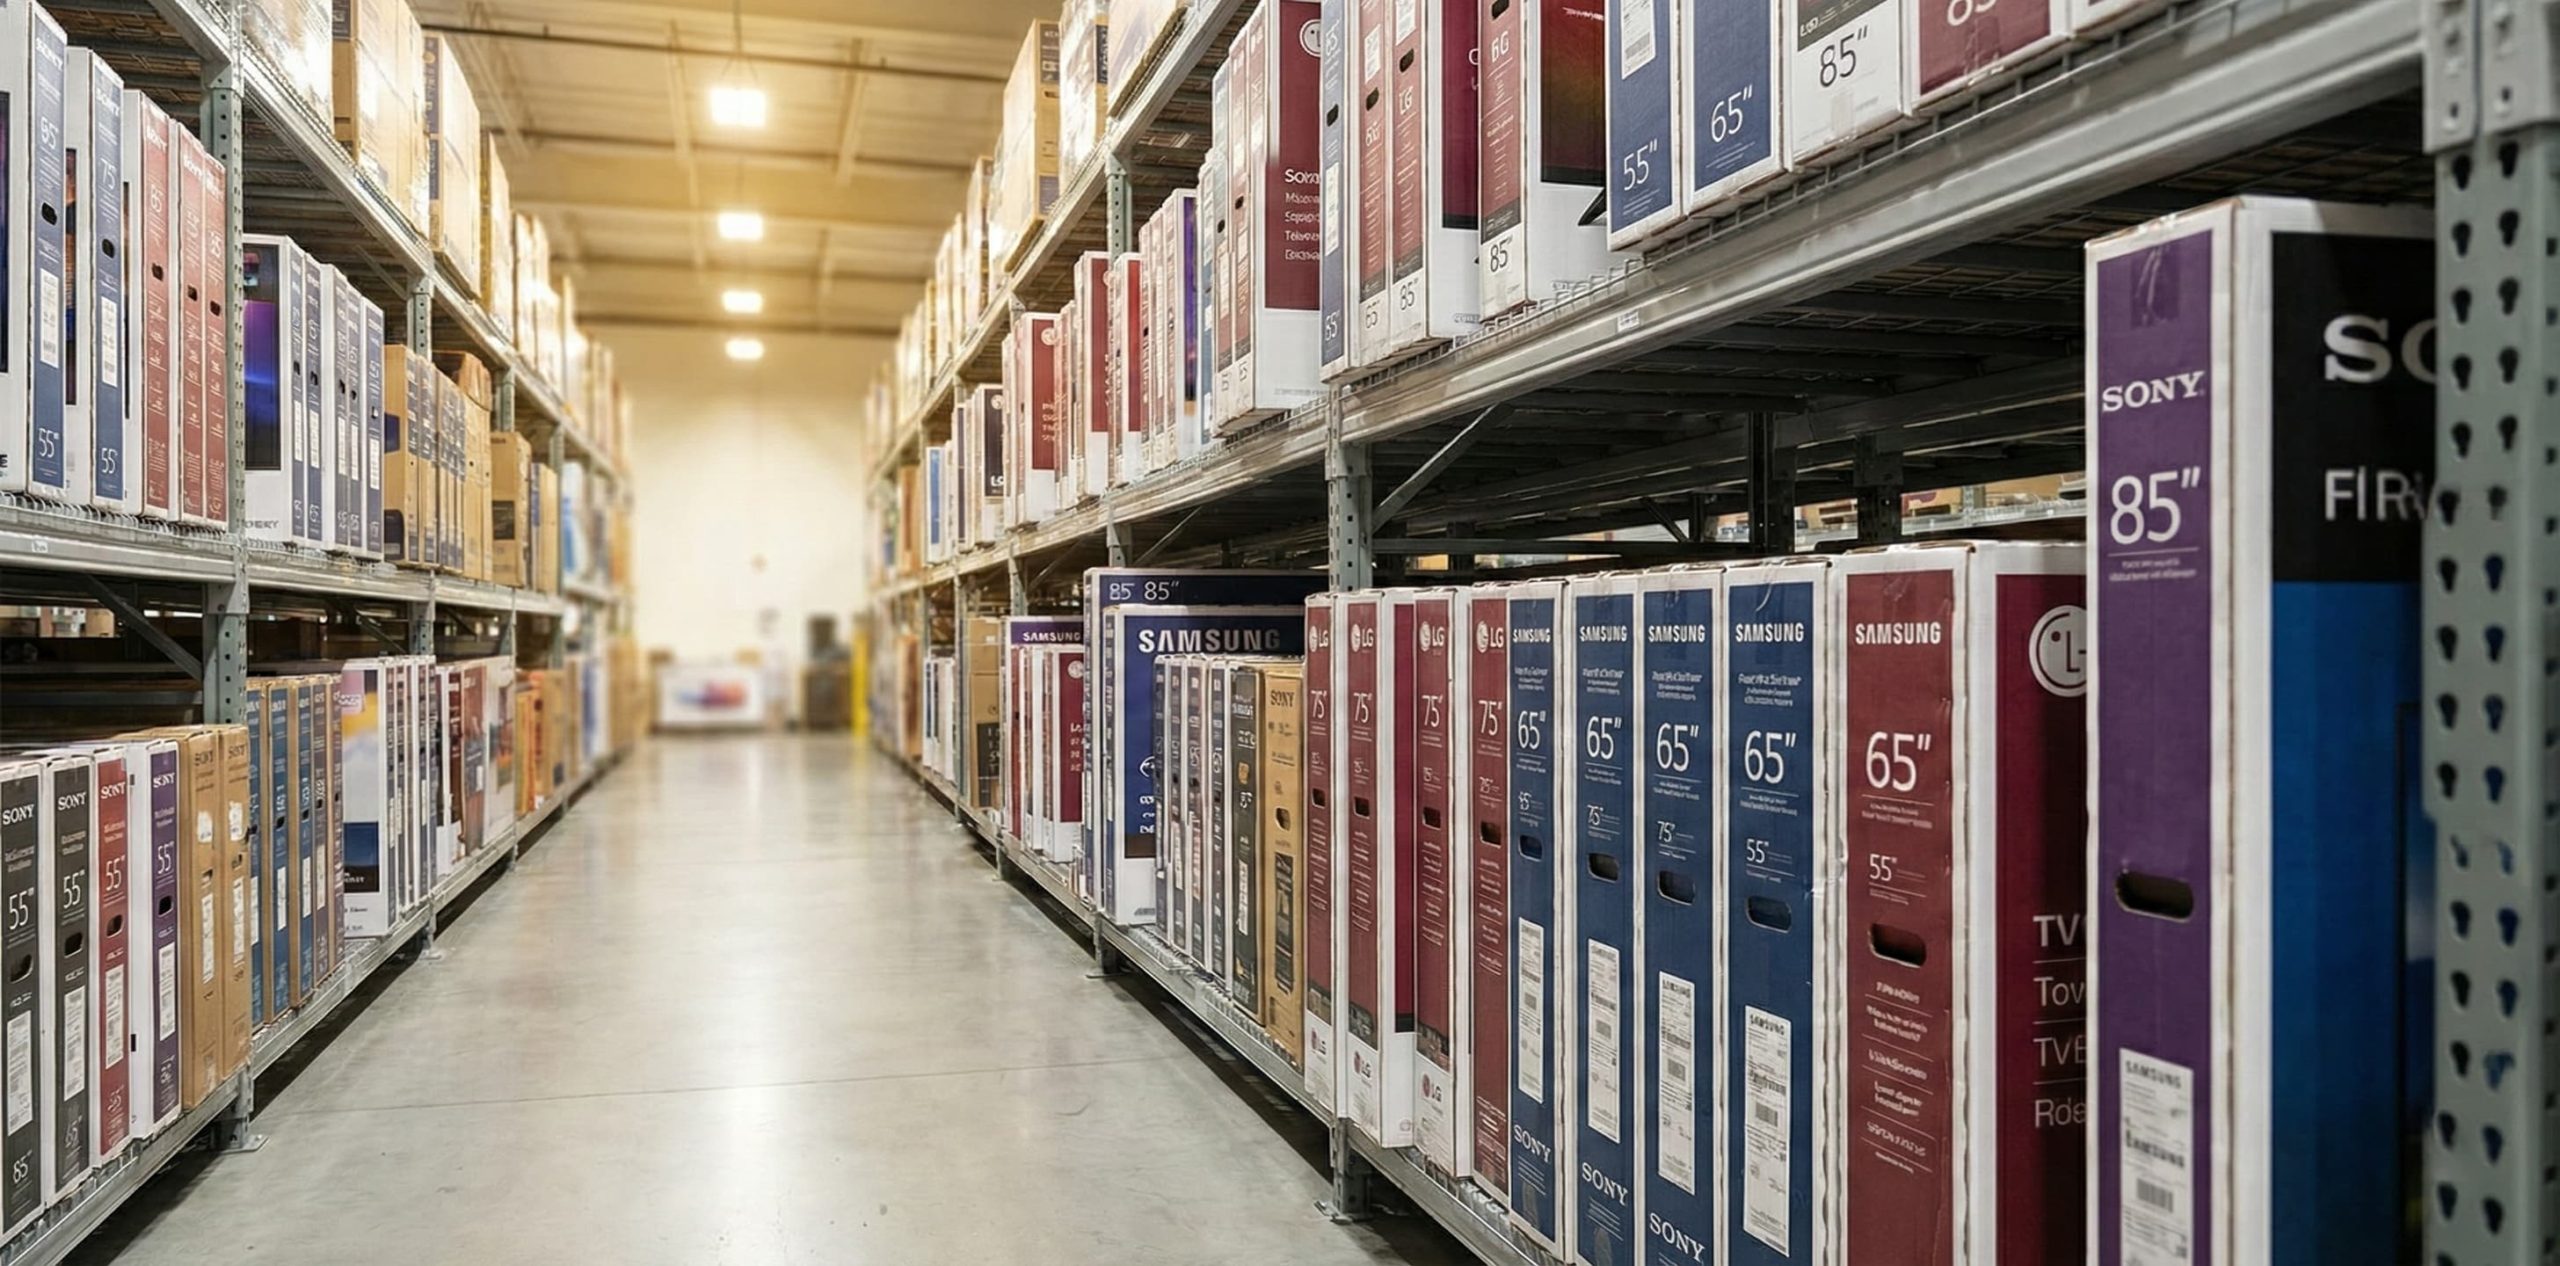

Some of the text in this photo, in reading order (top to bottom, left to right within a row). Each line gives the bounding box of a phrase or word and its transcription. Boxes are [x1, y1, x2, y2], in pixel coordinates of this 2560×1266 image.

[1820, 25, 1867, 87] 85"
[1711, 83, 1752, 142] 65"
[1623, 138, 1657, 191] 55"
[1490, 236, 1513, 273] 85"
[2102, 371, 2205, 412] SONY
[2110, 466, 2201, 544] 85"
[1144, 580, 1179, 600] 85"
[1023, 631, 1081, 641] SAMSUNG
[1138, 628, 1280, 653] SAMSUNG
[1431, 626, 1445, 648] LG
[1490, 627, 1504, 648] LG
[1580, 625, 1627, 642] SAMSUNG
[1648, 624, 1706, 642] SAMSUNG
[1735, 623, 1804, 643] SAMSUNG
[1855, 622, 1941, 645] SAMSUNG
[1518, 710, 1546, 750] 65"
[1587, 716, 1622, 760] 65"
[1656, 722, 1699, 772] 65"
[1744, 730, 1796, 784] 65"
[1866, 731, 1932, 792] 65"
[100, 781, 125, 799] SONY
[153, 772, 175, 788] SONY
[2, 804, 35, 825] SONY
[57, 791, 87, 811] SONY
[63, 869, 85, 909] 55"
[8, 887, 34, 930] 55"
[2126, 1060, 2181, 1089] SAMSUNG
[1514, 1125, 1551, 1163] SONY
[1582, 1162, 1628, 1206] SONY
[1650, 1213, 1705, 1262] SONY
